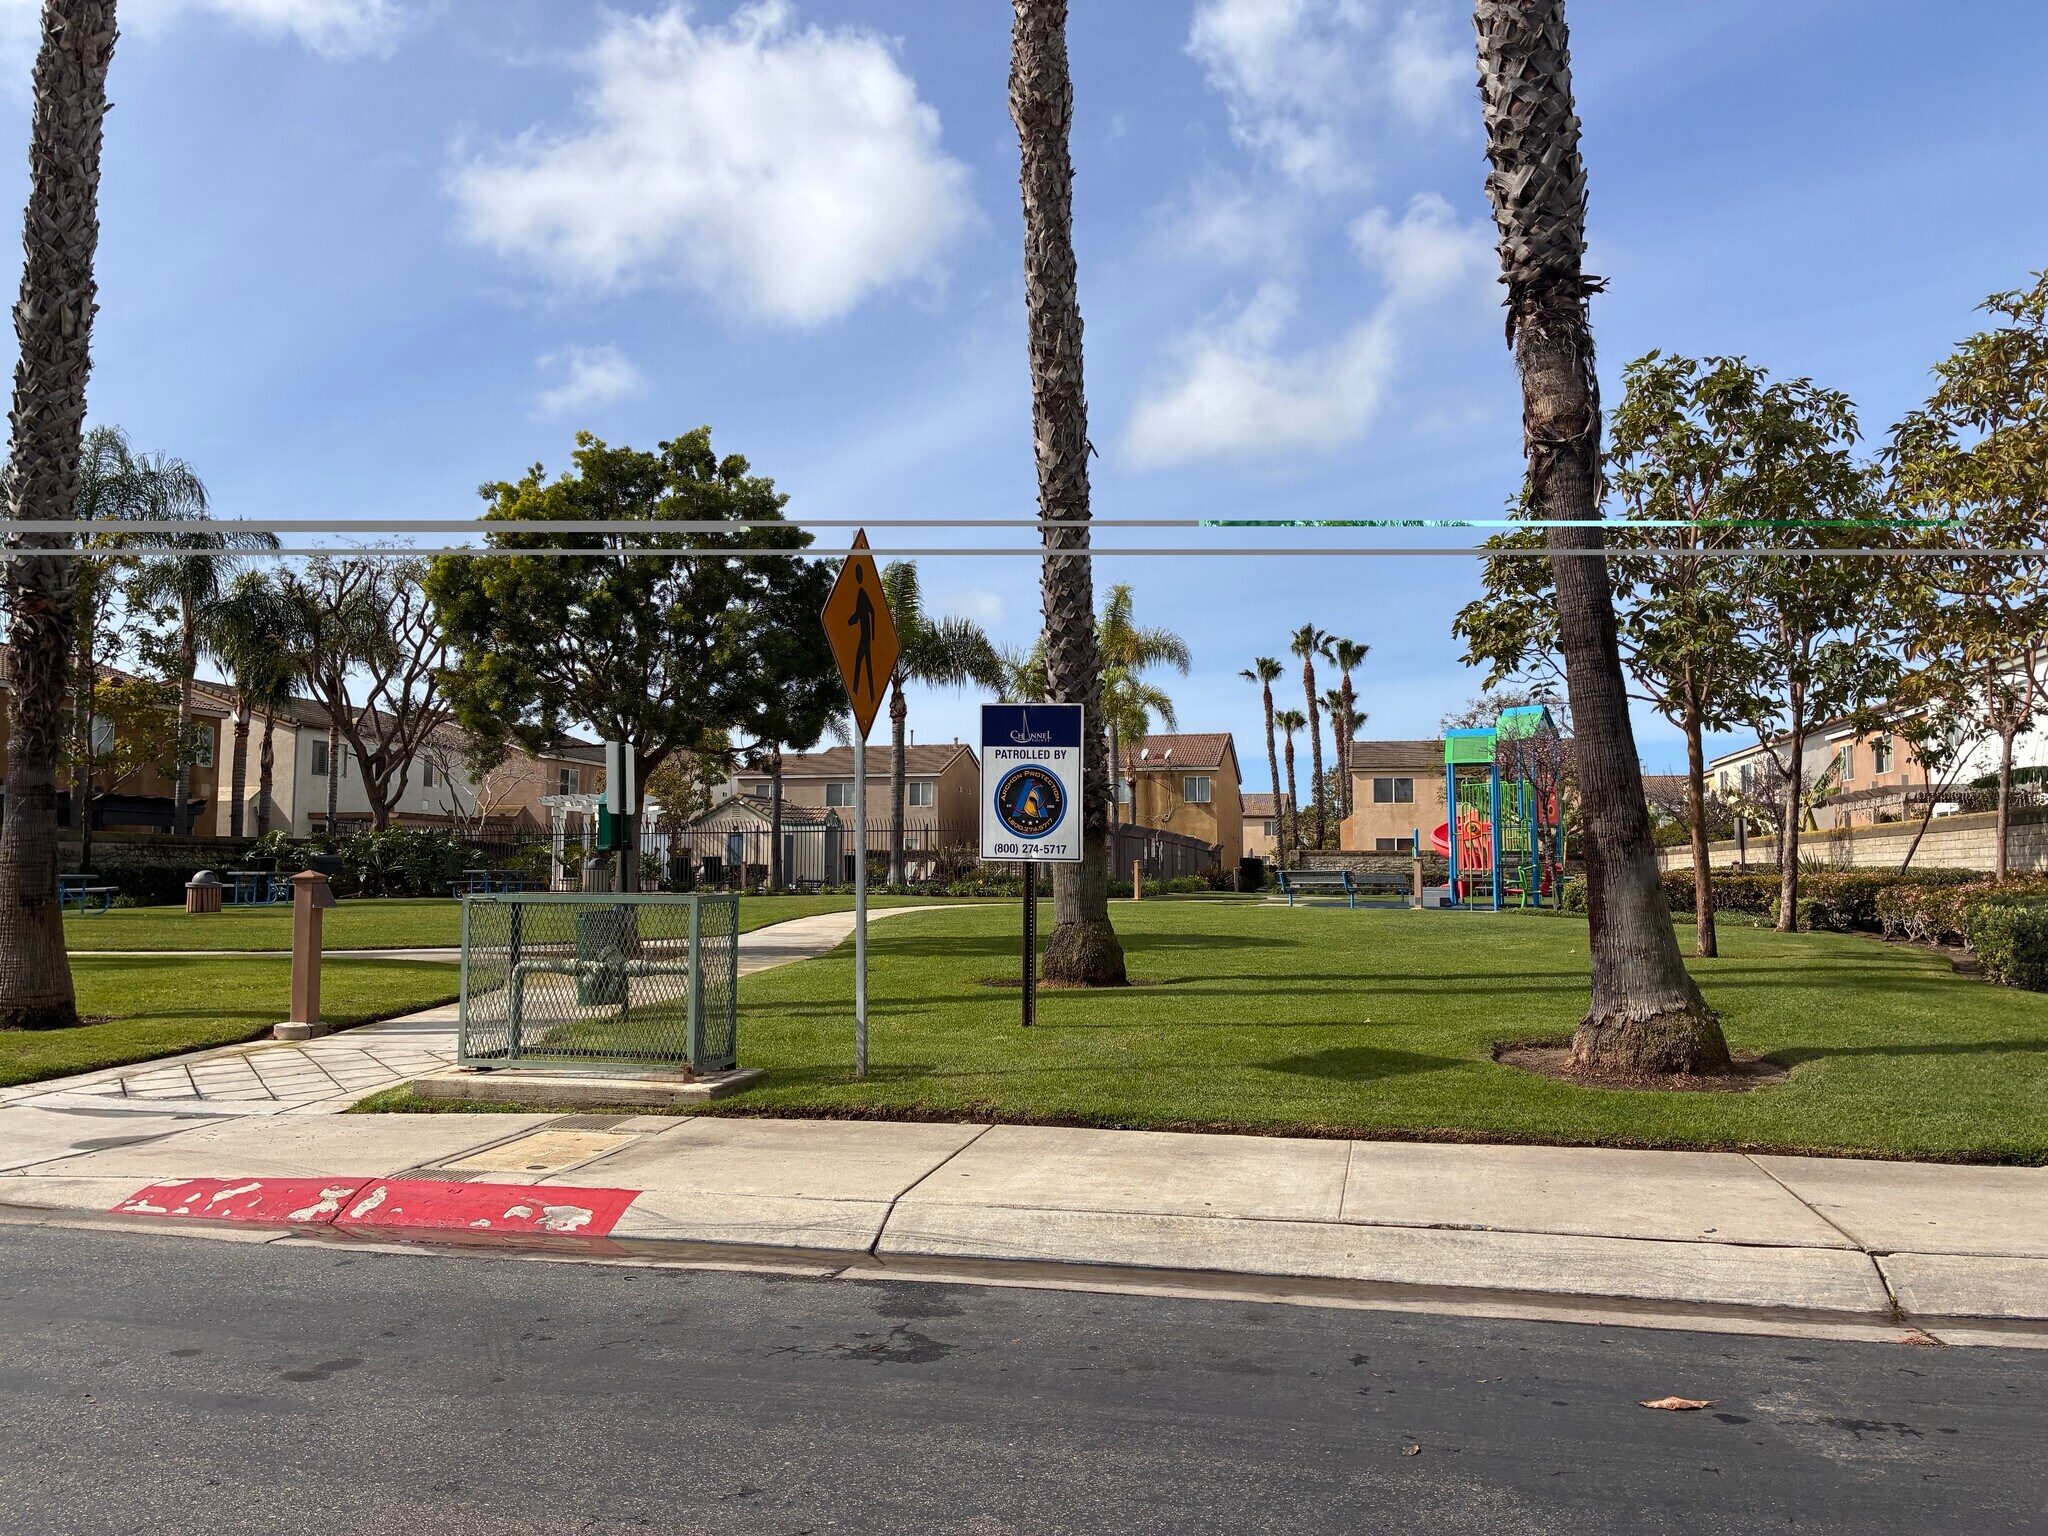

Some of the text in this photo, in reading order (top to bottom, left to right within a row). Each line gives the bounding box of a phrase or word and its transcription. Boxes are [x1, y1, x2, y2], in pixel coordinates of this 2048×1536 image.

[995, 749, 1067, 760] PATROLLED BY
[1000, 770, 1061, 802] ARCHON PROTECTION
[994, 844, 1067, 854] (800) 274-5717
